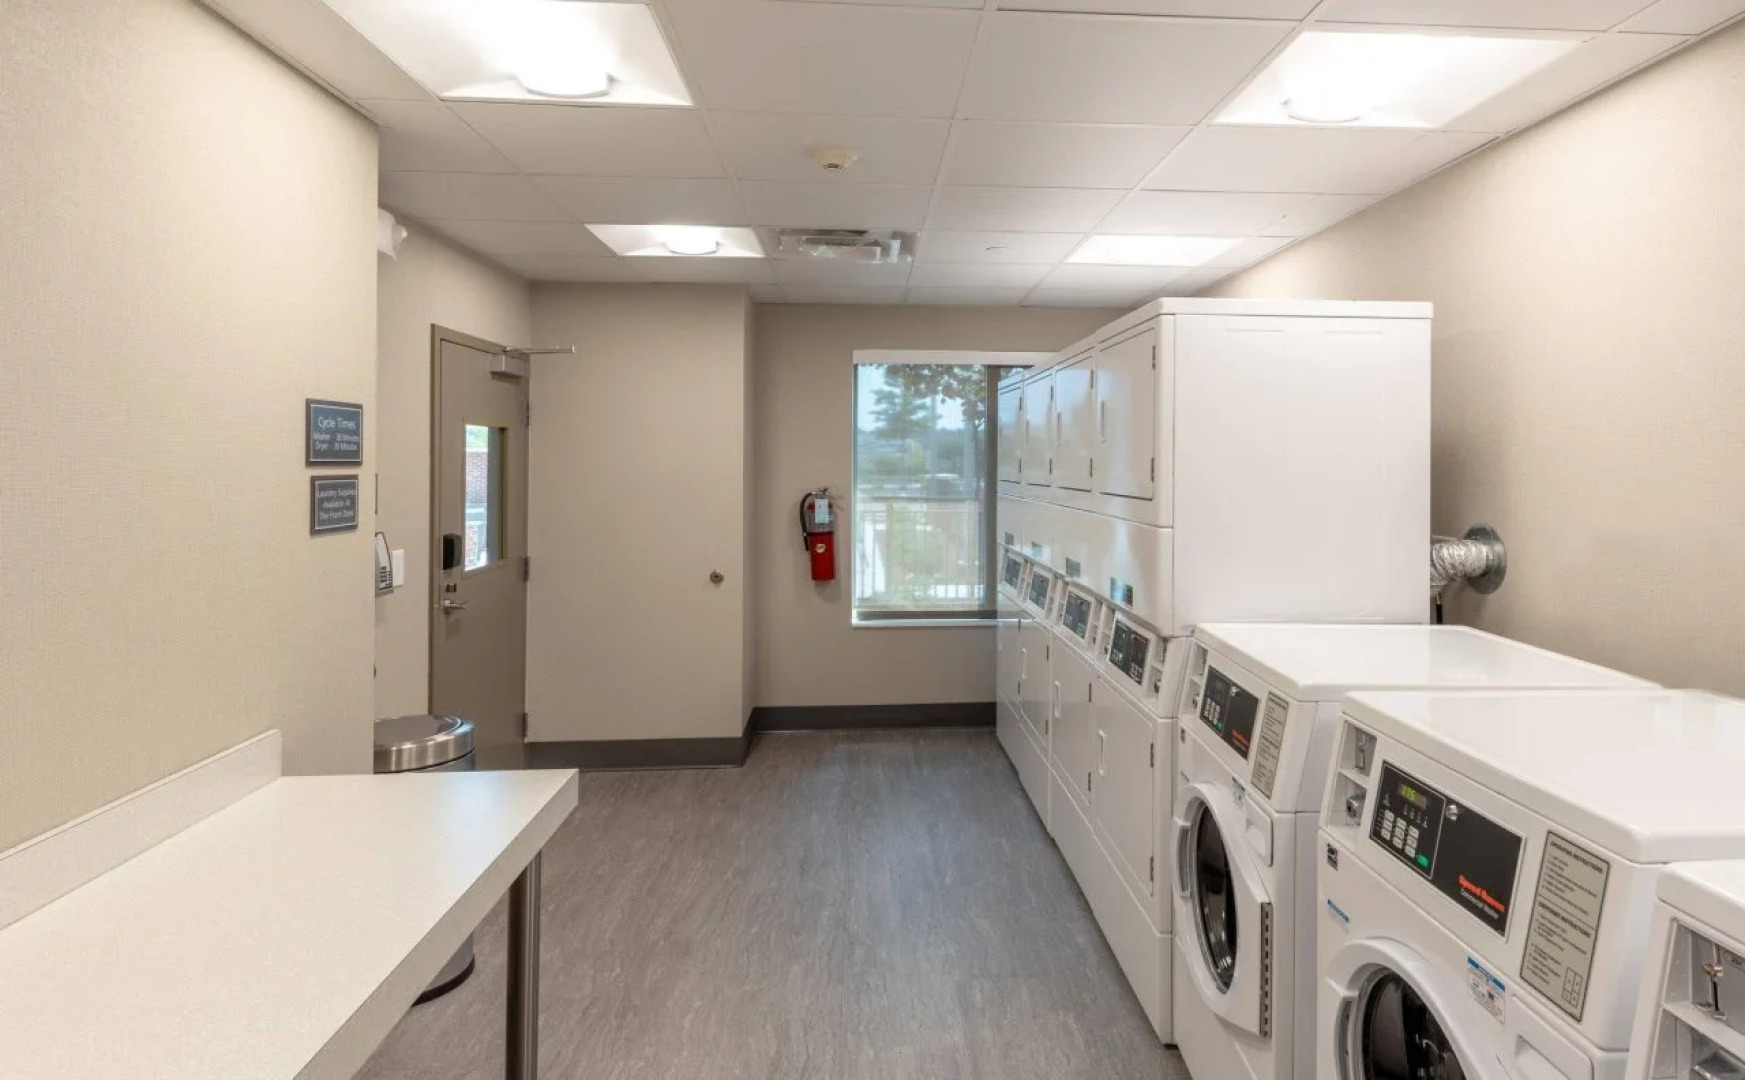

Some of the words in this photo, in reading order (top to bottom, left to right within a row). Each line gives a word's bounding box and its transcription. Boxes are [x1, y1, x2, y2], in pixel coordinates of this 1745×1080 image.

[318, 415, 336, 430] Cycle
[337, 417, 357, 430] Times
[1459, 874, 1482, 896] Speed
[1481, 889, 1506, 913] Queen
